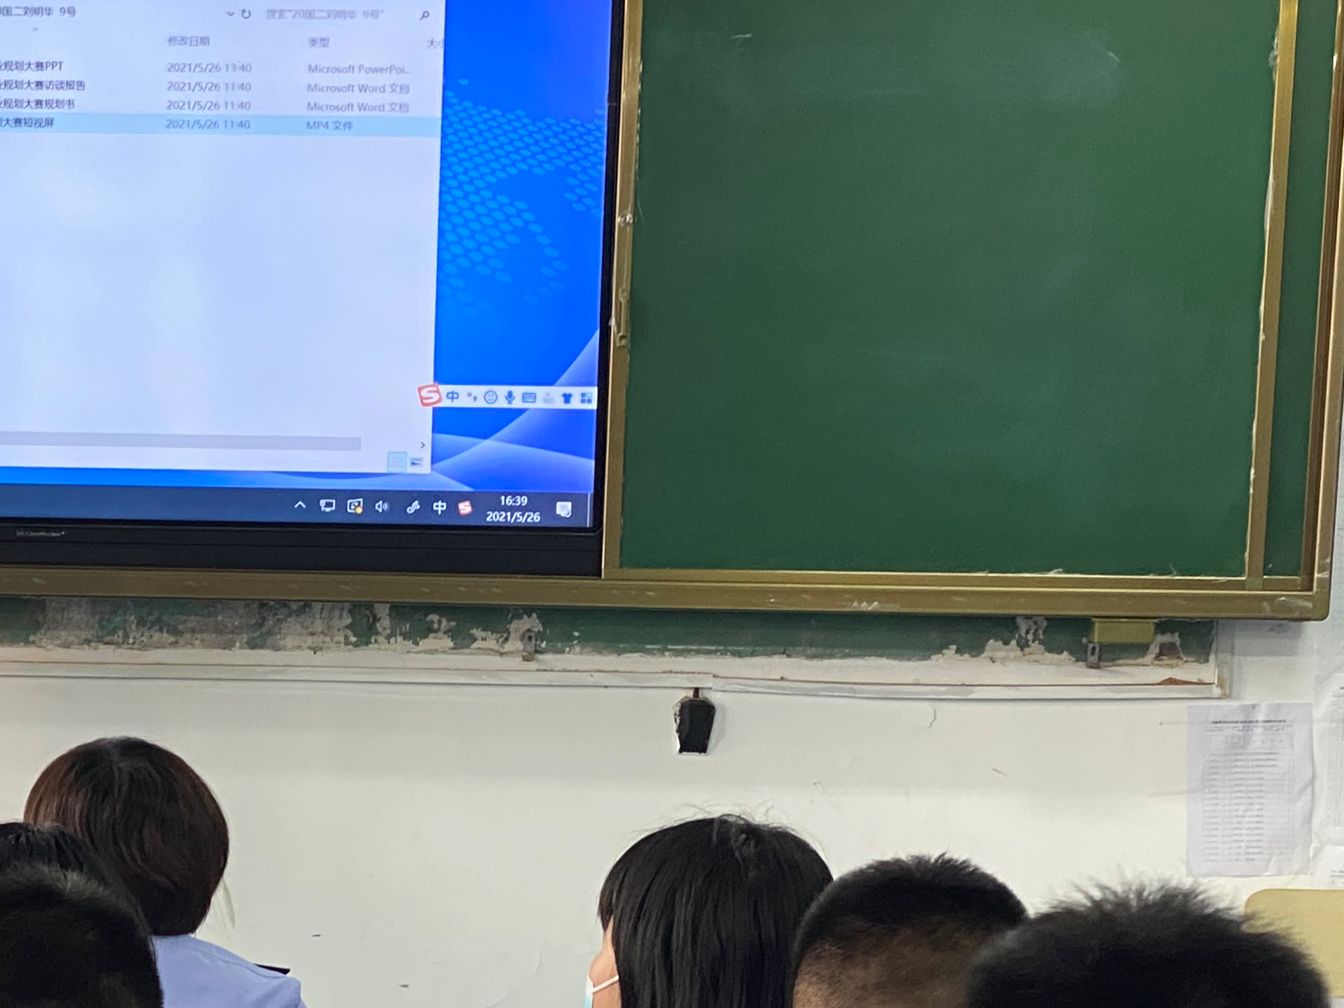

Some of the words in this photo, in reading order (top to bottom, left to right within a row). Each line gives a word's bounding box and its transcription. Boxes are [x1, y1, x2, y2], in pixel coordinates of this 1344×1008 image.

[167, 36, 210, 47] 修改日期
[308, 37, 330, 48] 类型
[167, 63, 222, 74] 2021/5/26
[308, 64, 355, 75] Microsoft
[166, 82, 221, 93] 2021/5/26
[307, 83, 355, 94] Microsoft
[358, 83, 386, 94] Word
[389, 84, 410, 95] 文档
[166, 101, 221, 112] 2021/5/26
[307, 102, 354, 112] Microsoft
[357, 102, 385, 113] Word
[388, 103, 409, 114] 文档
[165, 119, 220, 130] 2021/5/26
[306, 120, 330, 130] MP4
[333, 120, 353, 131] 文件
[446, 390, 459, 403] 中
[500, 496, 528, 506] 16:39
[433, 500, 447, 515] 中
[486, 511, 541, 523] 2021/5/26
